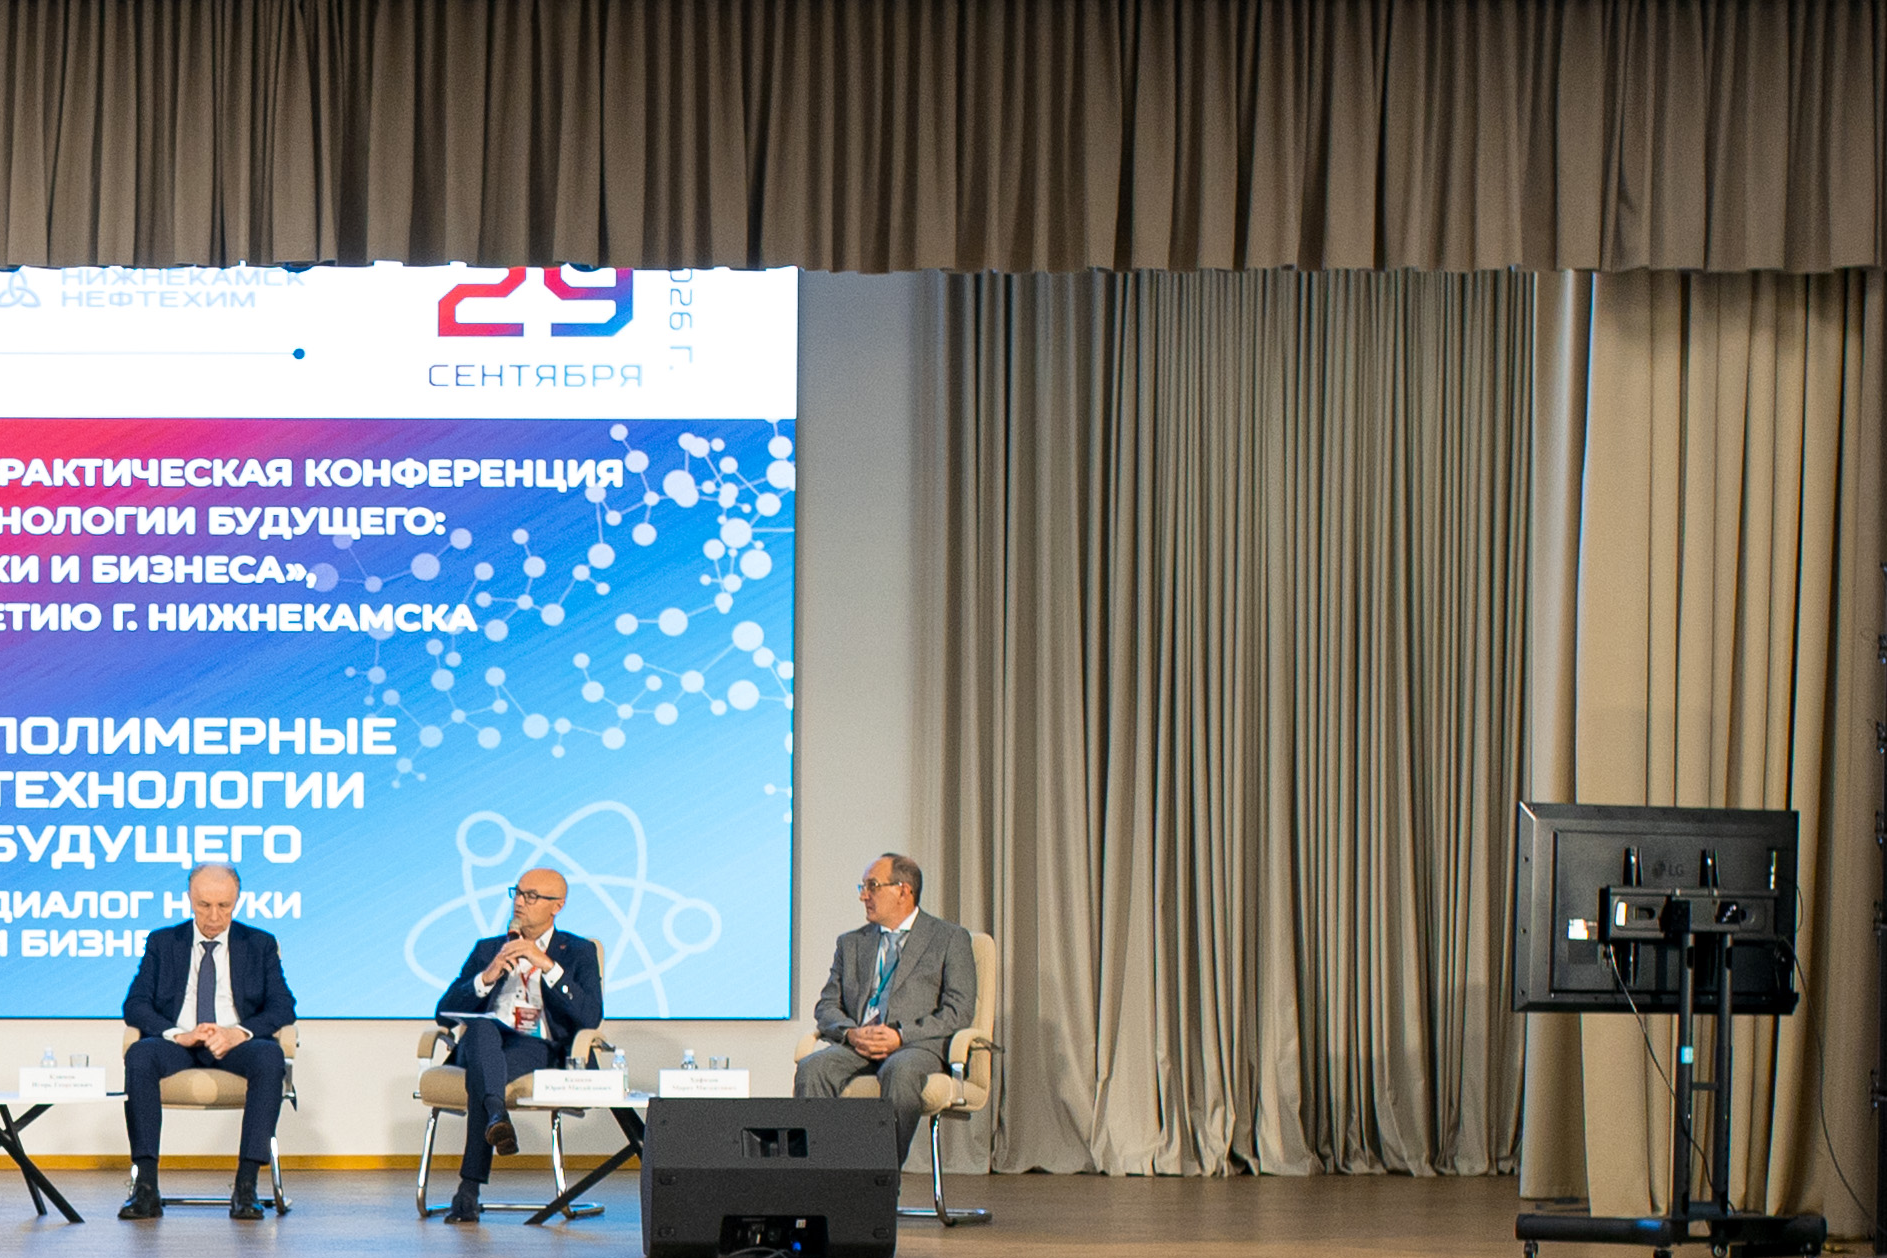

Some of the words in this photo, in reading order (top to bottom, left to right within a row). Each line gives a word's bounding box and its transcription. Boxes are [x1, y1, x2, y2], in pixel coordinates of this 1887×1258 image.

[60, 269, 305, 287] НИЖНЕКАМСК
[60, 290, 257, 308] НЕФТЕХИМ
[437, 267, 634, 338] 29
[428, 363, 643, 388] СЕНТЯБРЯ
[305, 458, 624, 493] КОНФЕРЕНЦИЯ
[209, 506, 447, 540] БУДУЩЕГО:
[51, 555, 80, 583] И
[92, 555, 318, 589] БИЗНЕСА»,
[113, 603, 139, 632] Г.
[148, 603, 478, 632] НИЖНЕКАМСКА
[163, 891, 302, 919] НУКИ
